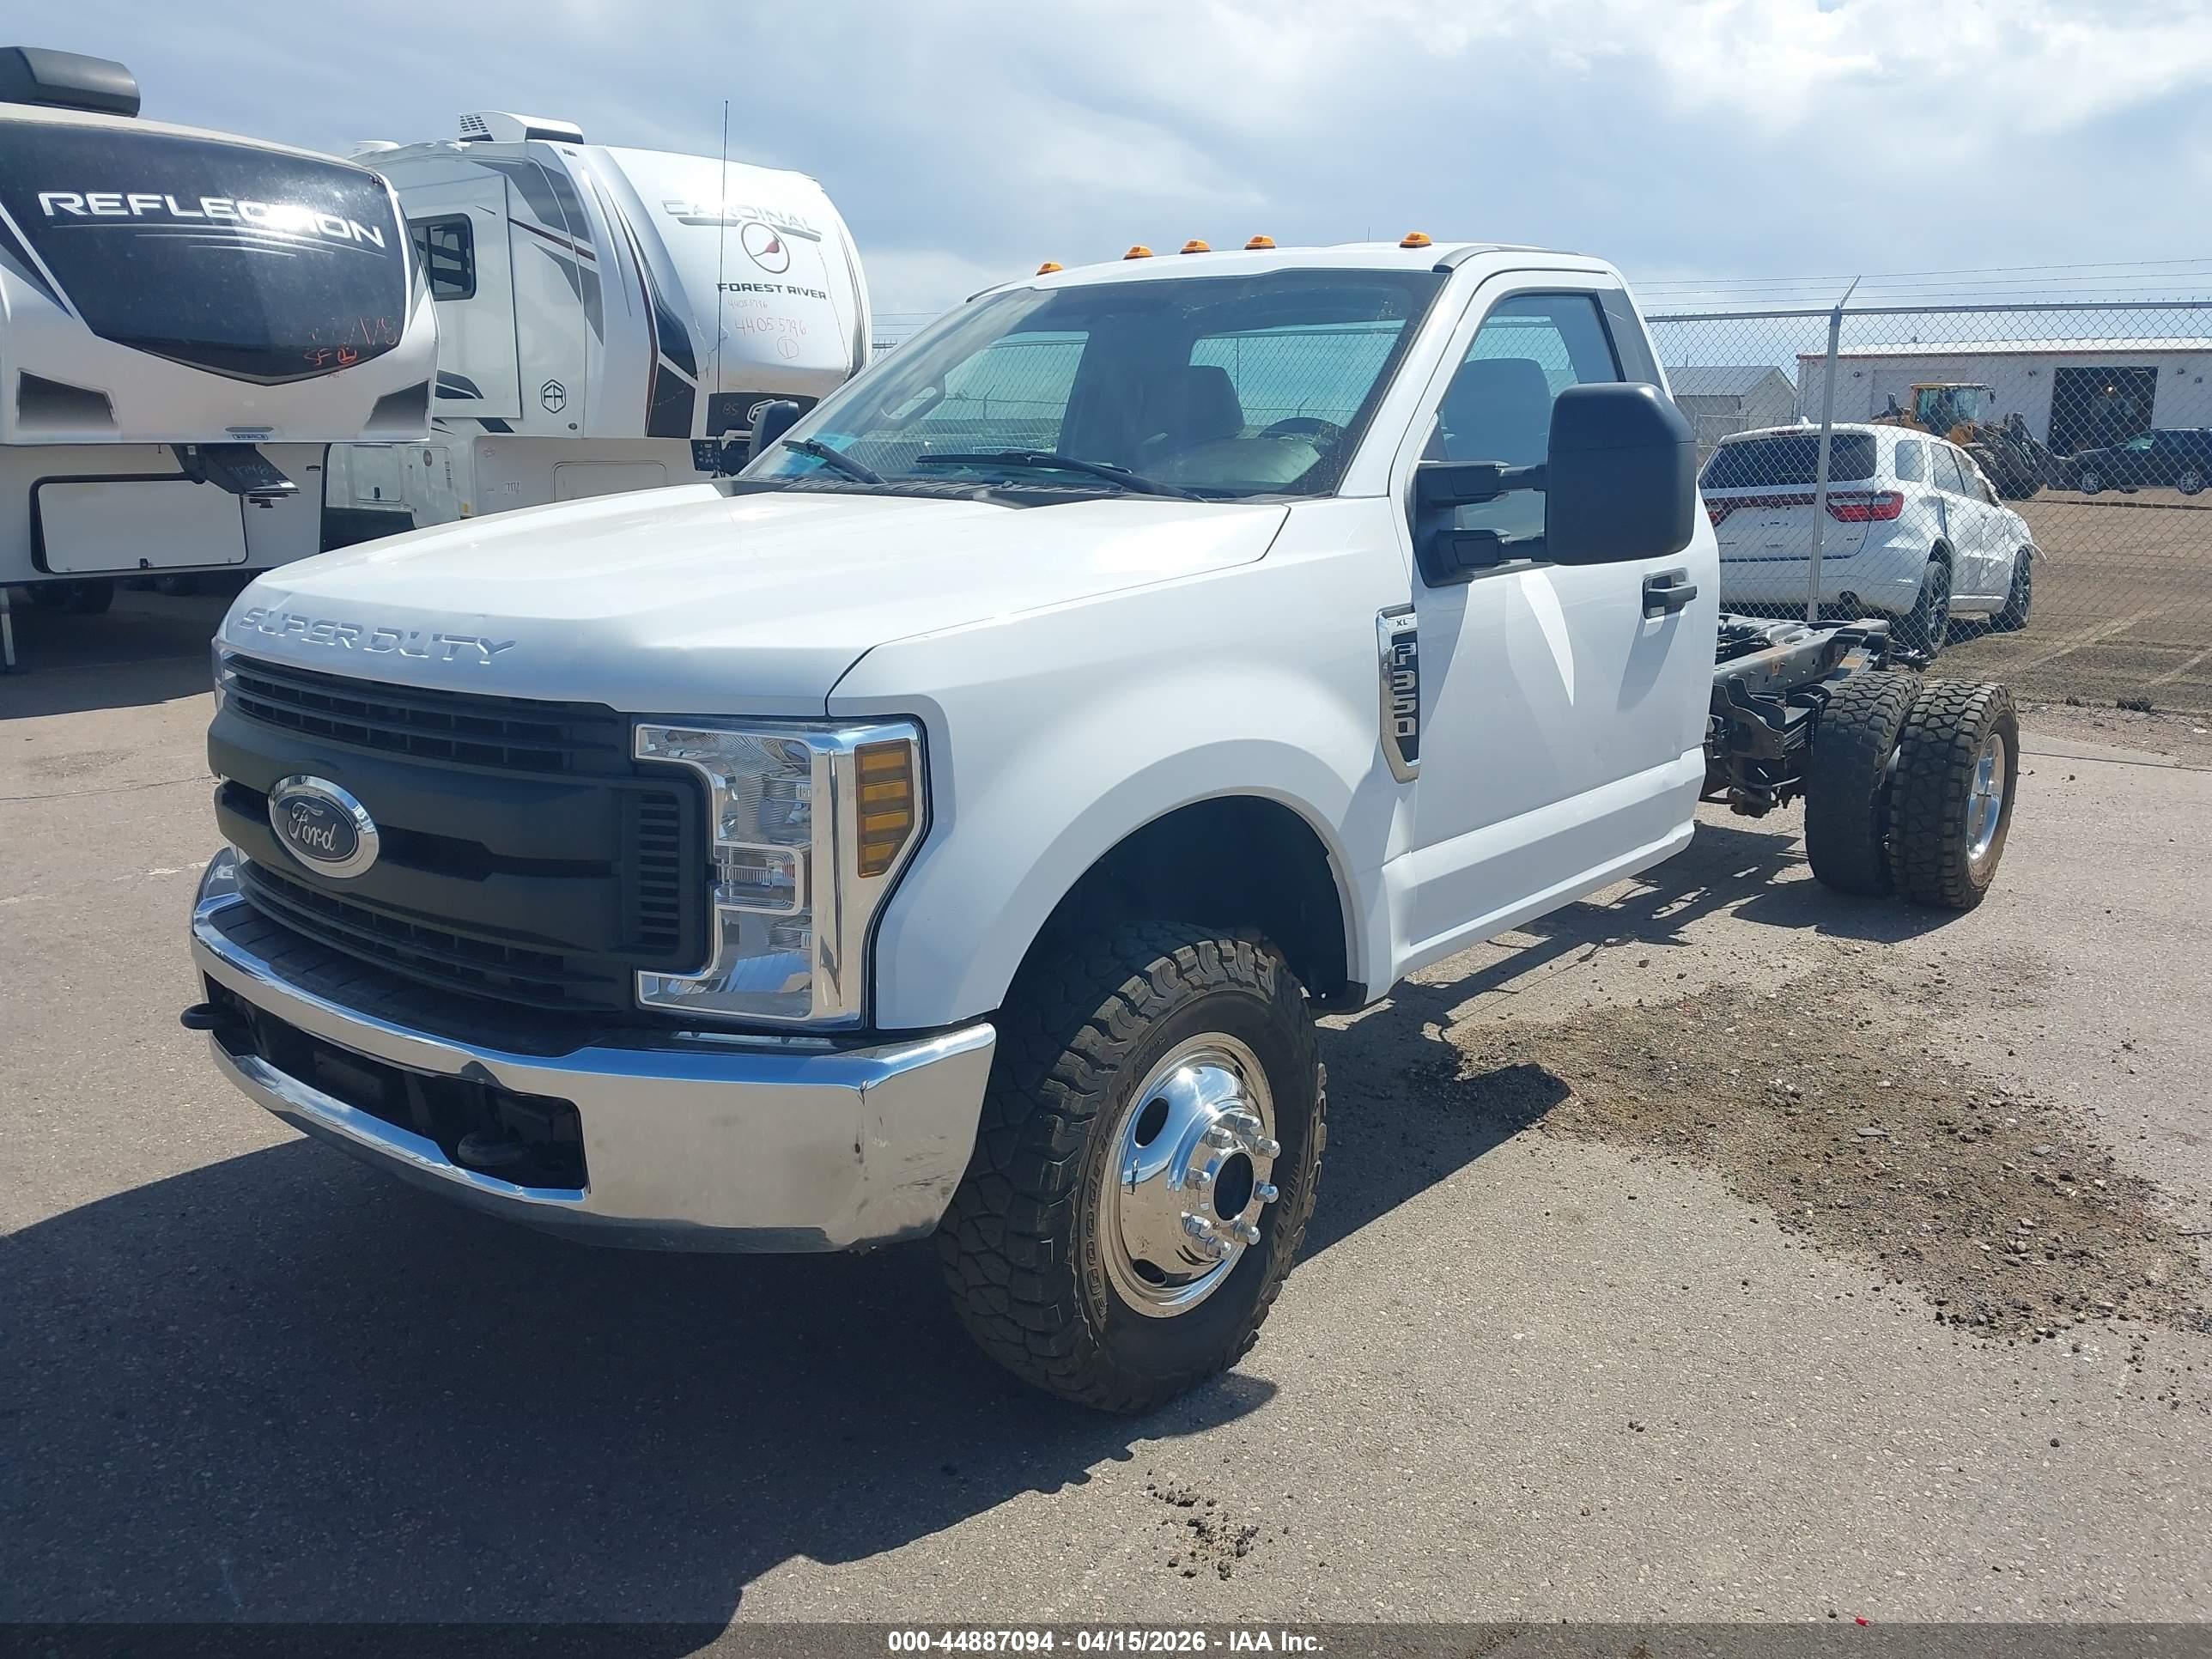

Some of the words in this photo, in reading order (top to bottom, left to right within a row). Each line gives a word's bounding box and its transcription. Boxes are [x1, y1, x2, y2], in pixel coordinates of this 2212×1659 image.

[38, 191, 385, 247] REFLECION
[661, 200, 822, 236] CADINAL
[716, 283, 782, 293] FOREST
[787, 286, 827, 301] RIVER
[238, 606, 364, 649] SUPER
[362, 627, 517, 665] DUTY
[1396, 618, 1408, 627] XL
[288, 801, 337, 852] Ford
